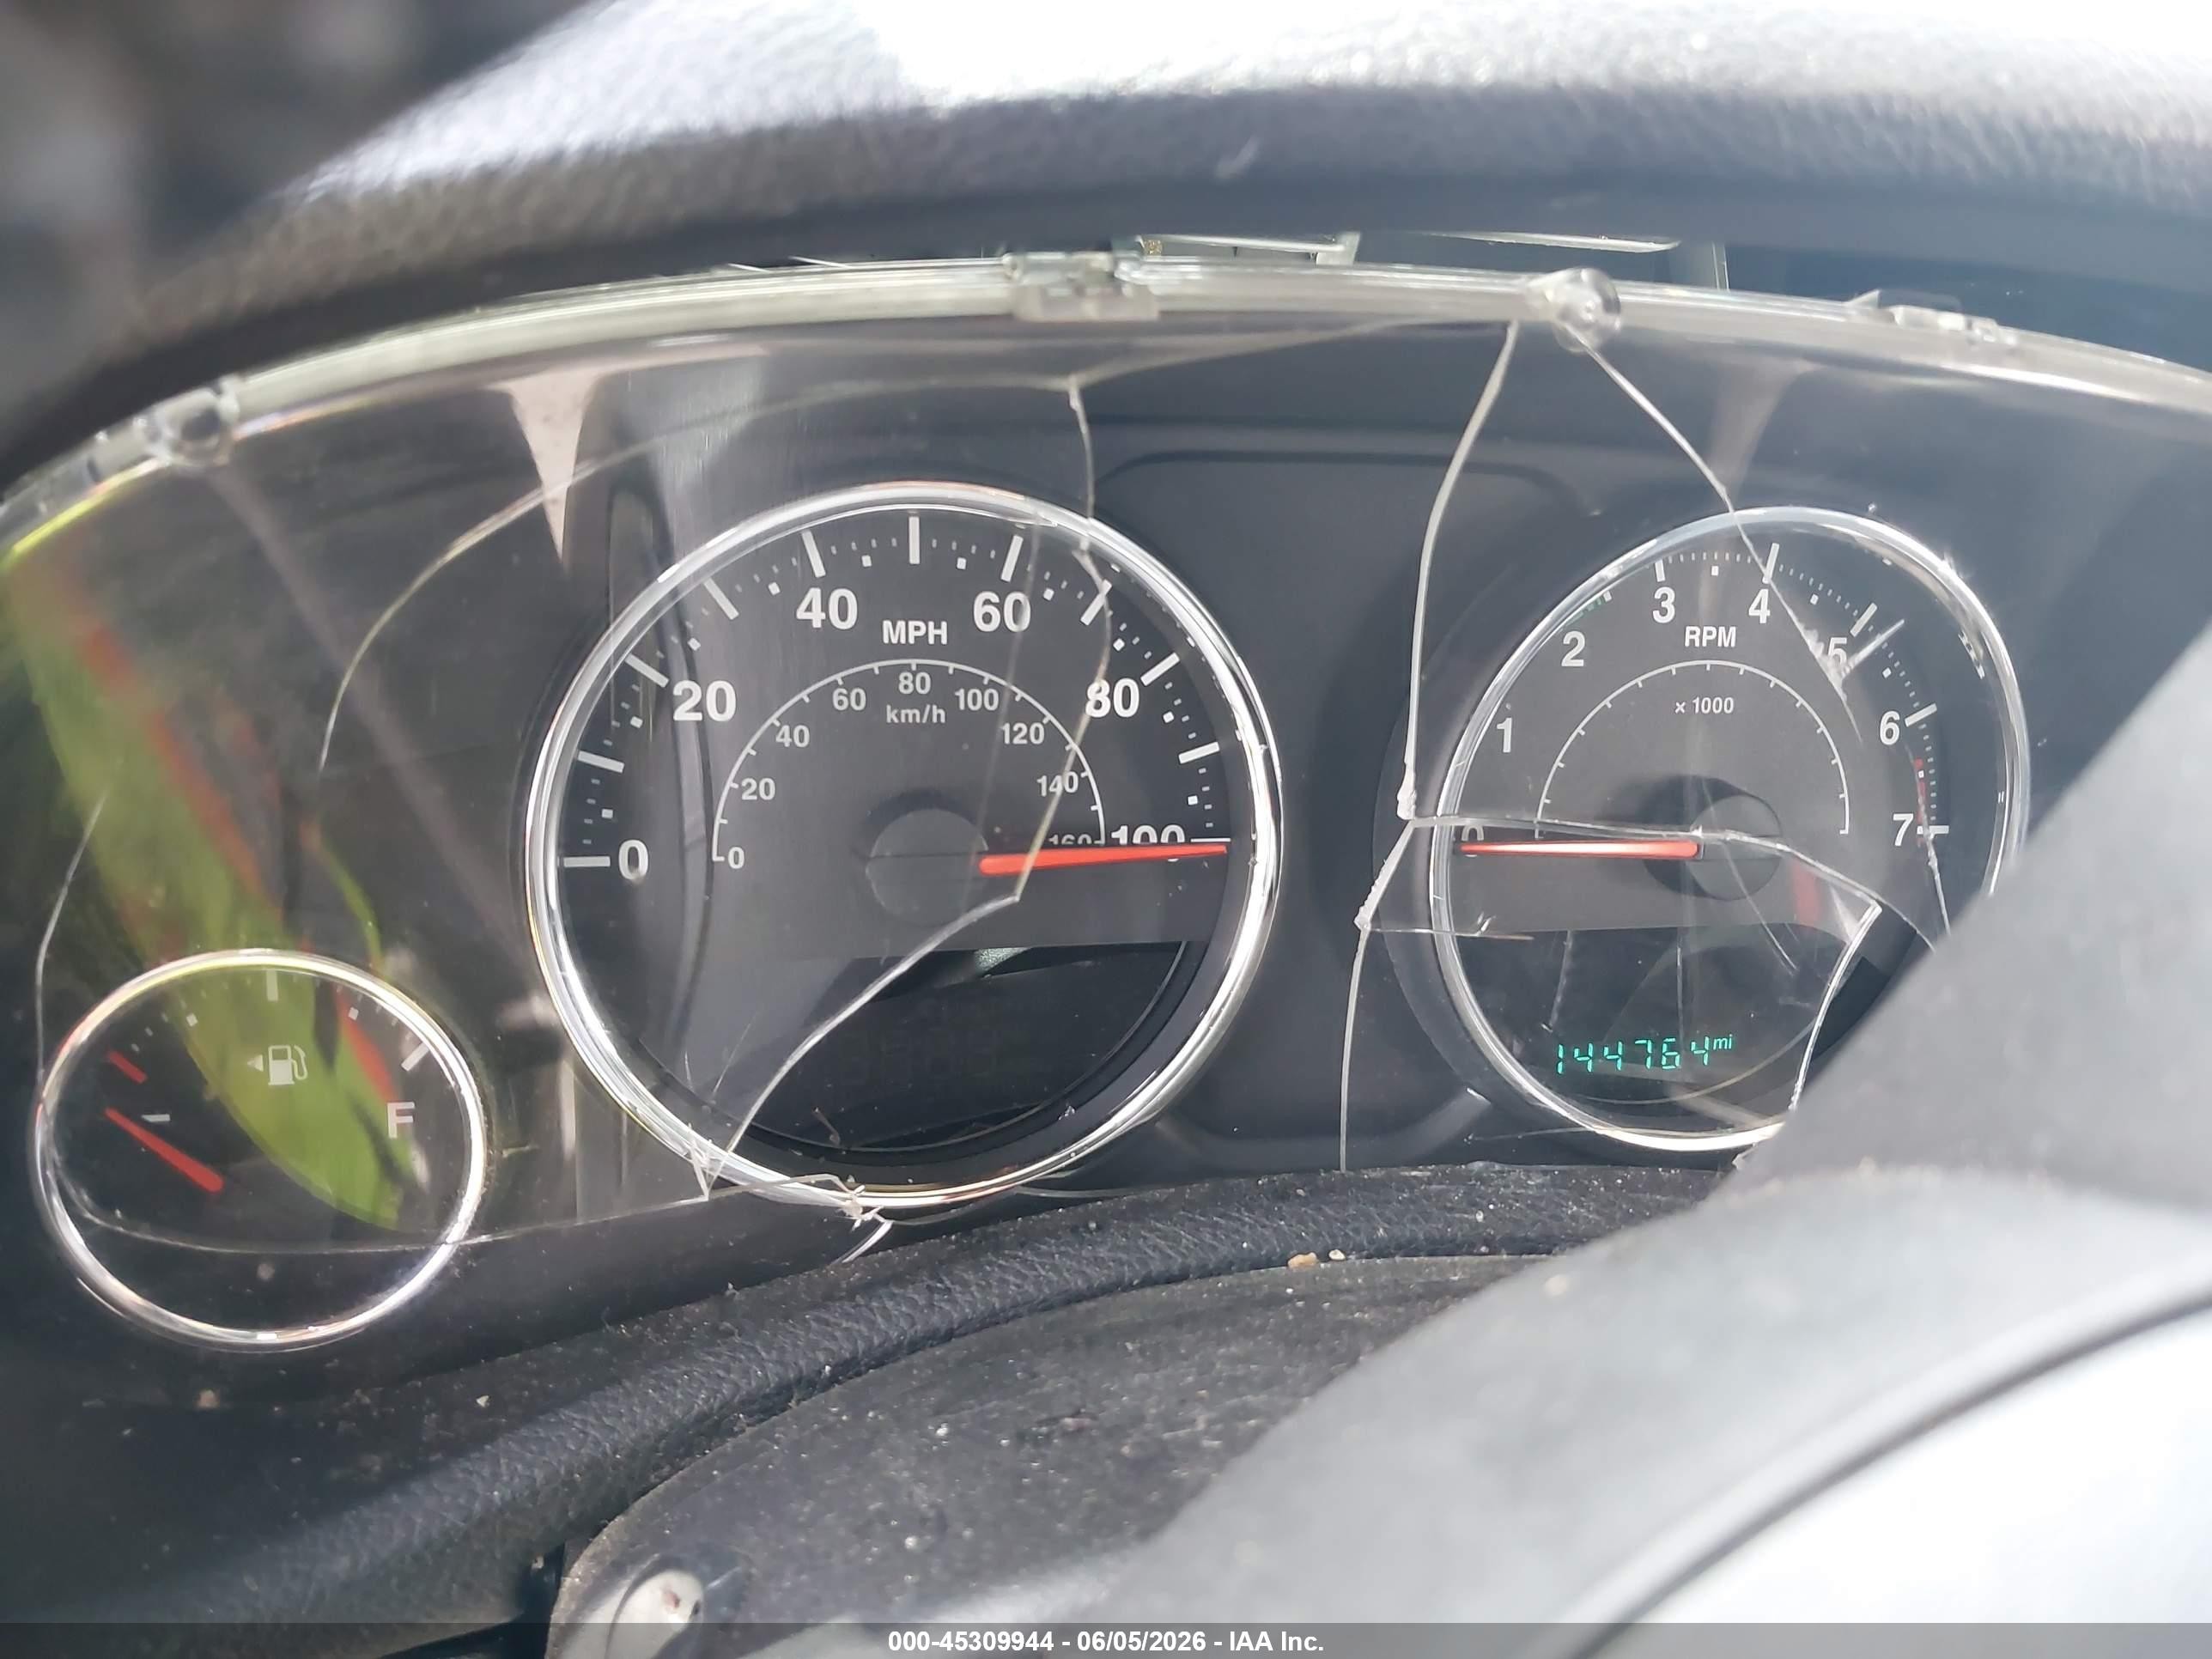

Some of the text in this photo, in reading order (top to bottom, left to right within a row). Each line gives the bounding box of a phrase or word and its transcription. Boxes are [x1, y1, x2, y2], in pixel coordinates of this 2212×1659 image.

[797, 588, 858, 629] 40
[973, 591, 1031, 633] 60
[1652, 586, 1675, 623] 3
[1748, 589, 1771, 624] 4
[882, 620, 948, 645] MPH
[1561, 630, 1586, 667] 2
[1684, 626, 1737, 647] RPM
[832, 688, 866, 711] 60
[898, 672, 932, 695] 80
[955, 688, 1000, 711] 100
[1085, 678, 1140, 718] 80
[672, 681, 737, 721] 20
[885, 704, 946, 723] km/h
[1692, 696, 1735, 714] 1000
[775, 725, 810, 747] 40
[1001, 722, 1045, 744] 120
[1497, 717, 1513, 753] 1
[1879, 710, 1900, 745] 6
[741, 778, 776, 800] 20
[1036, 772, 1079, 797] 140
[1893, 813, 1914, 847] 7
[618, 839, 649, 879] 0
[728, 847, 744, 869] 0
[1557, 1033, 1733, 1074] 144764 mi
[387, 1102, 415, 1139] F
